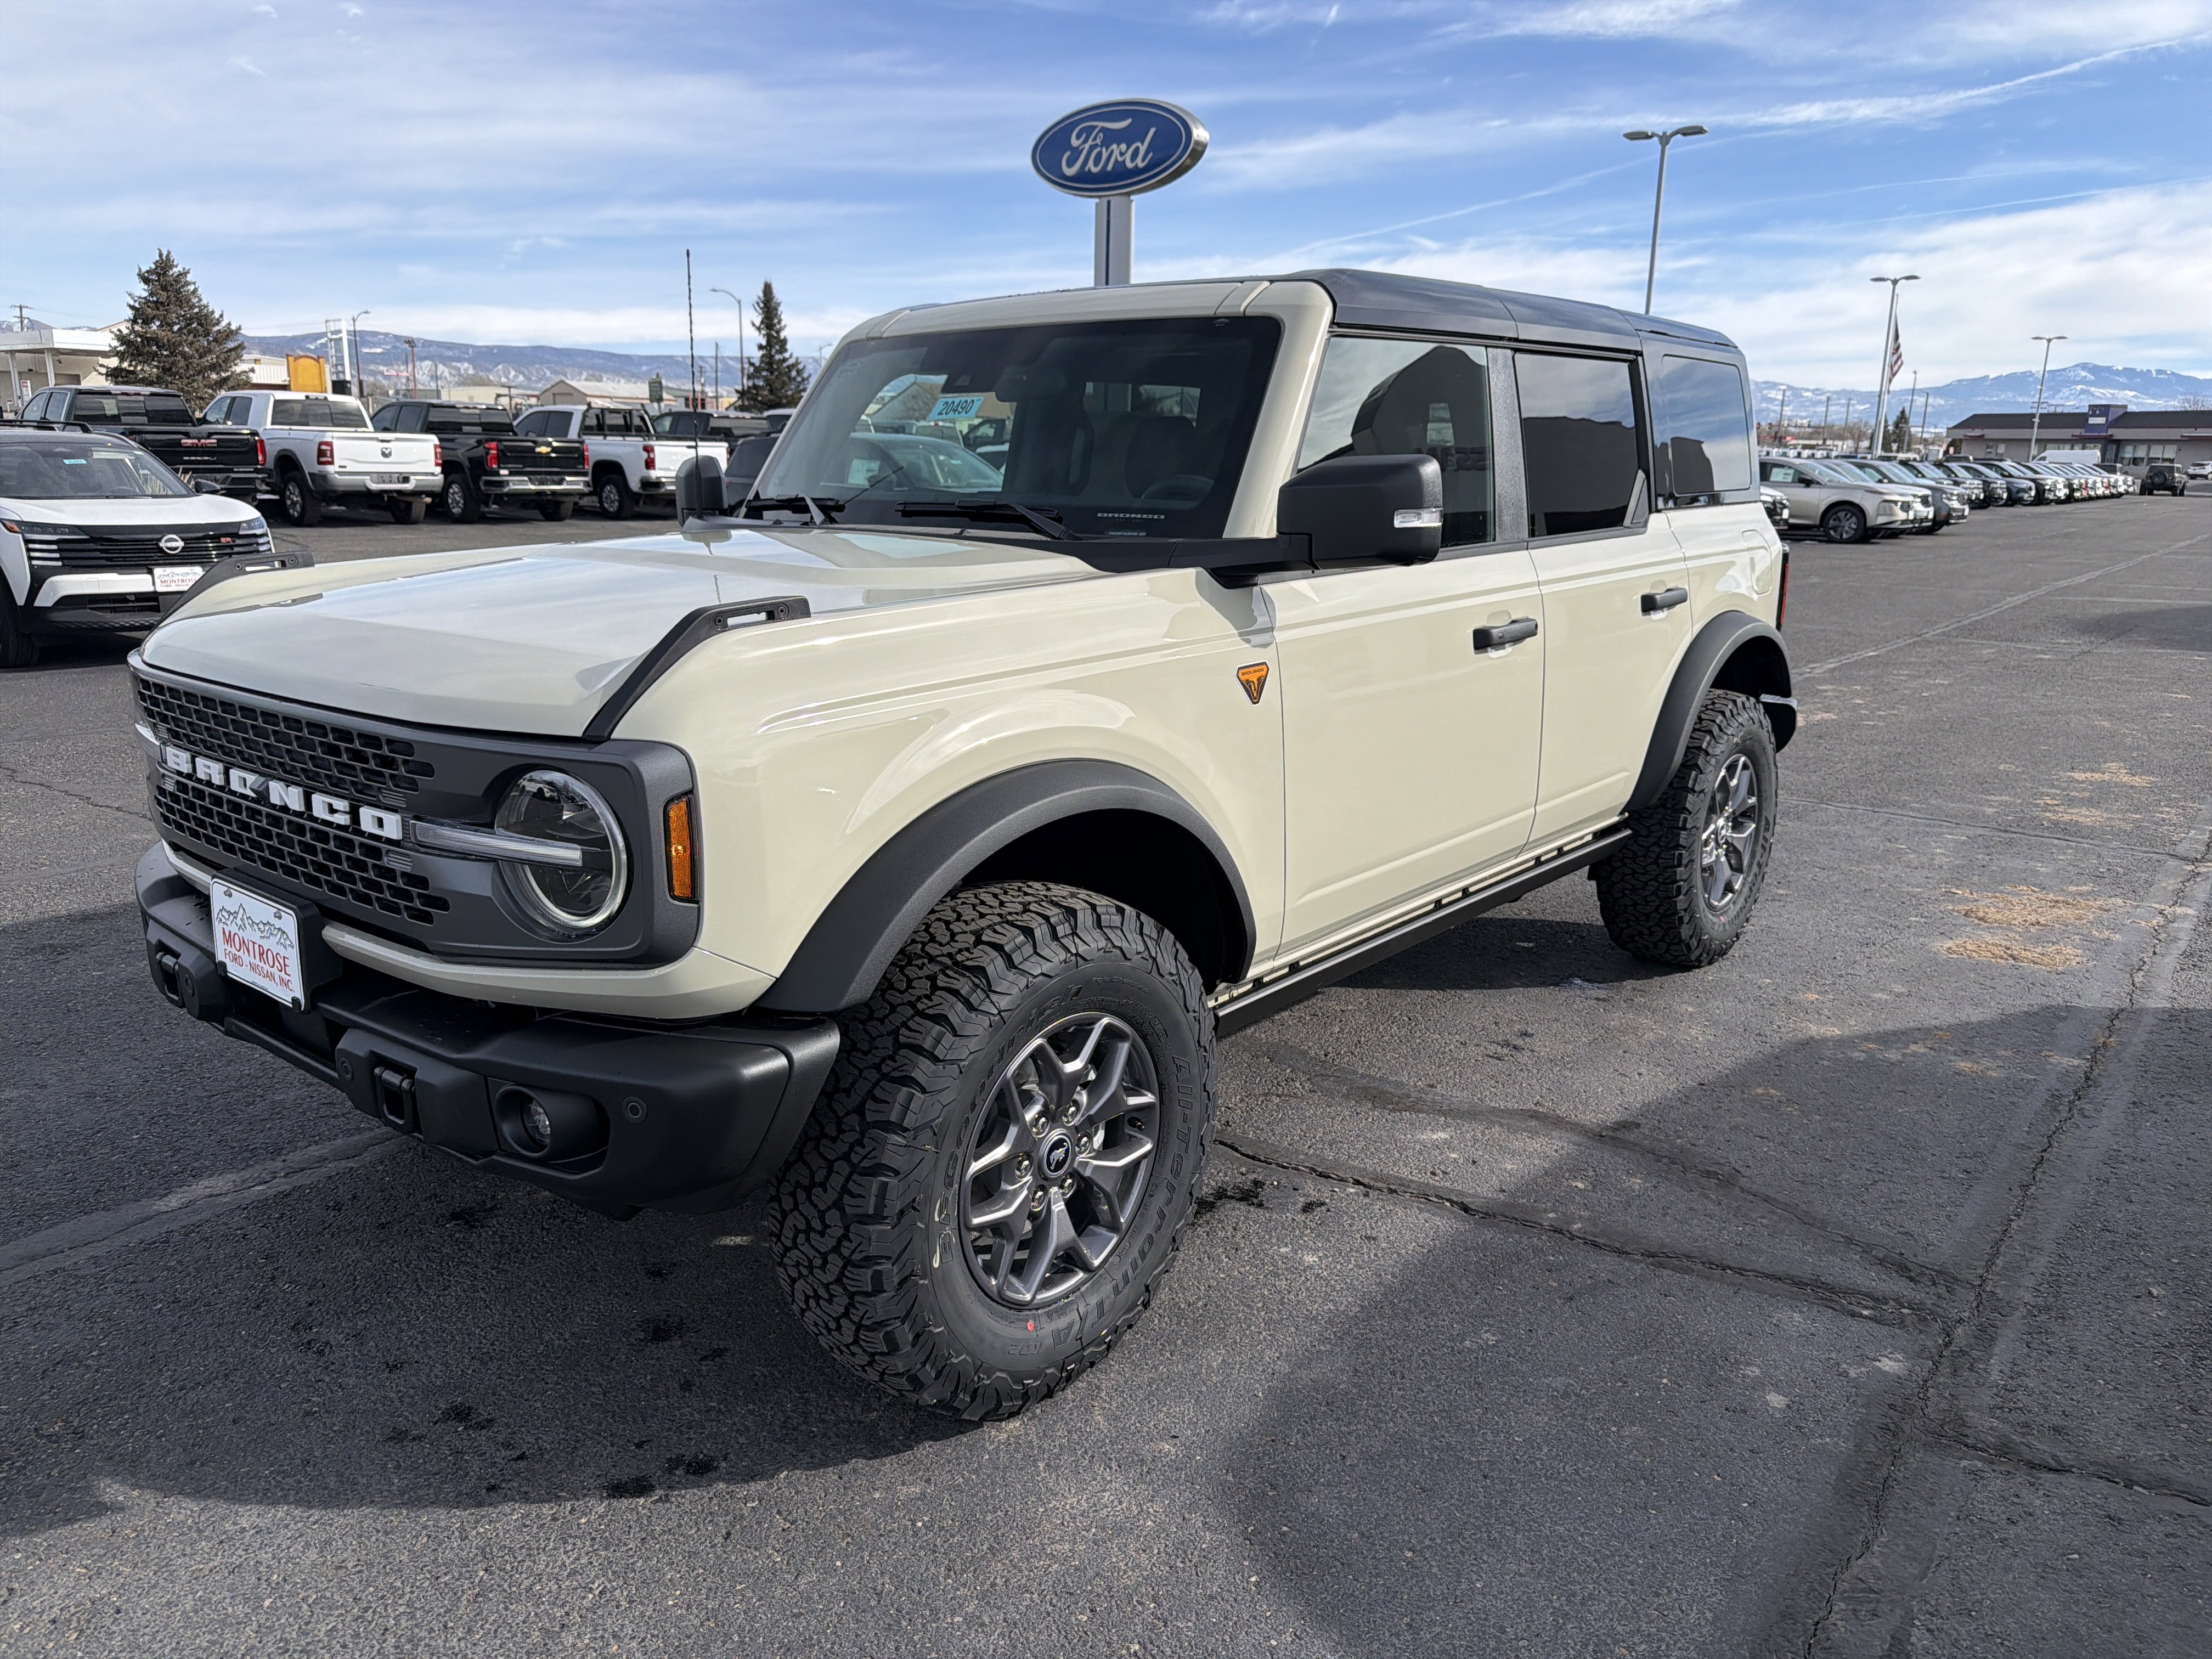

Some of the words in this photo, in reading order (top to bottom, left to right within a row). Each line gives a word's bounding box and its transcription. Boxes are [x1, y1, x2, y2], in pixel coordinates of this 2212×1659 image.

[1062, 118, 1156, 176] Ford
[937, 399, 975, 416] 20490
[166, 746, 403, 840] BRONCO
[222, 927, 291, 977] MONTROSE
[224, 949, 243, 967] FORD
[249, 960, 279, 986] NISSAN,
[279, 975, 295, 993] INC.
[939, 985, 1083, 1263] BFGoodrich
[1113, 1054, 1193, 1299] All-Terrain
